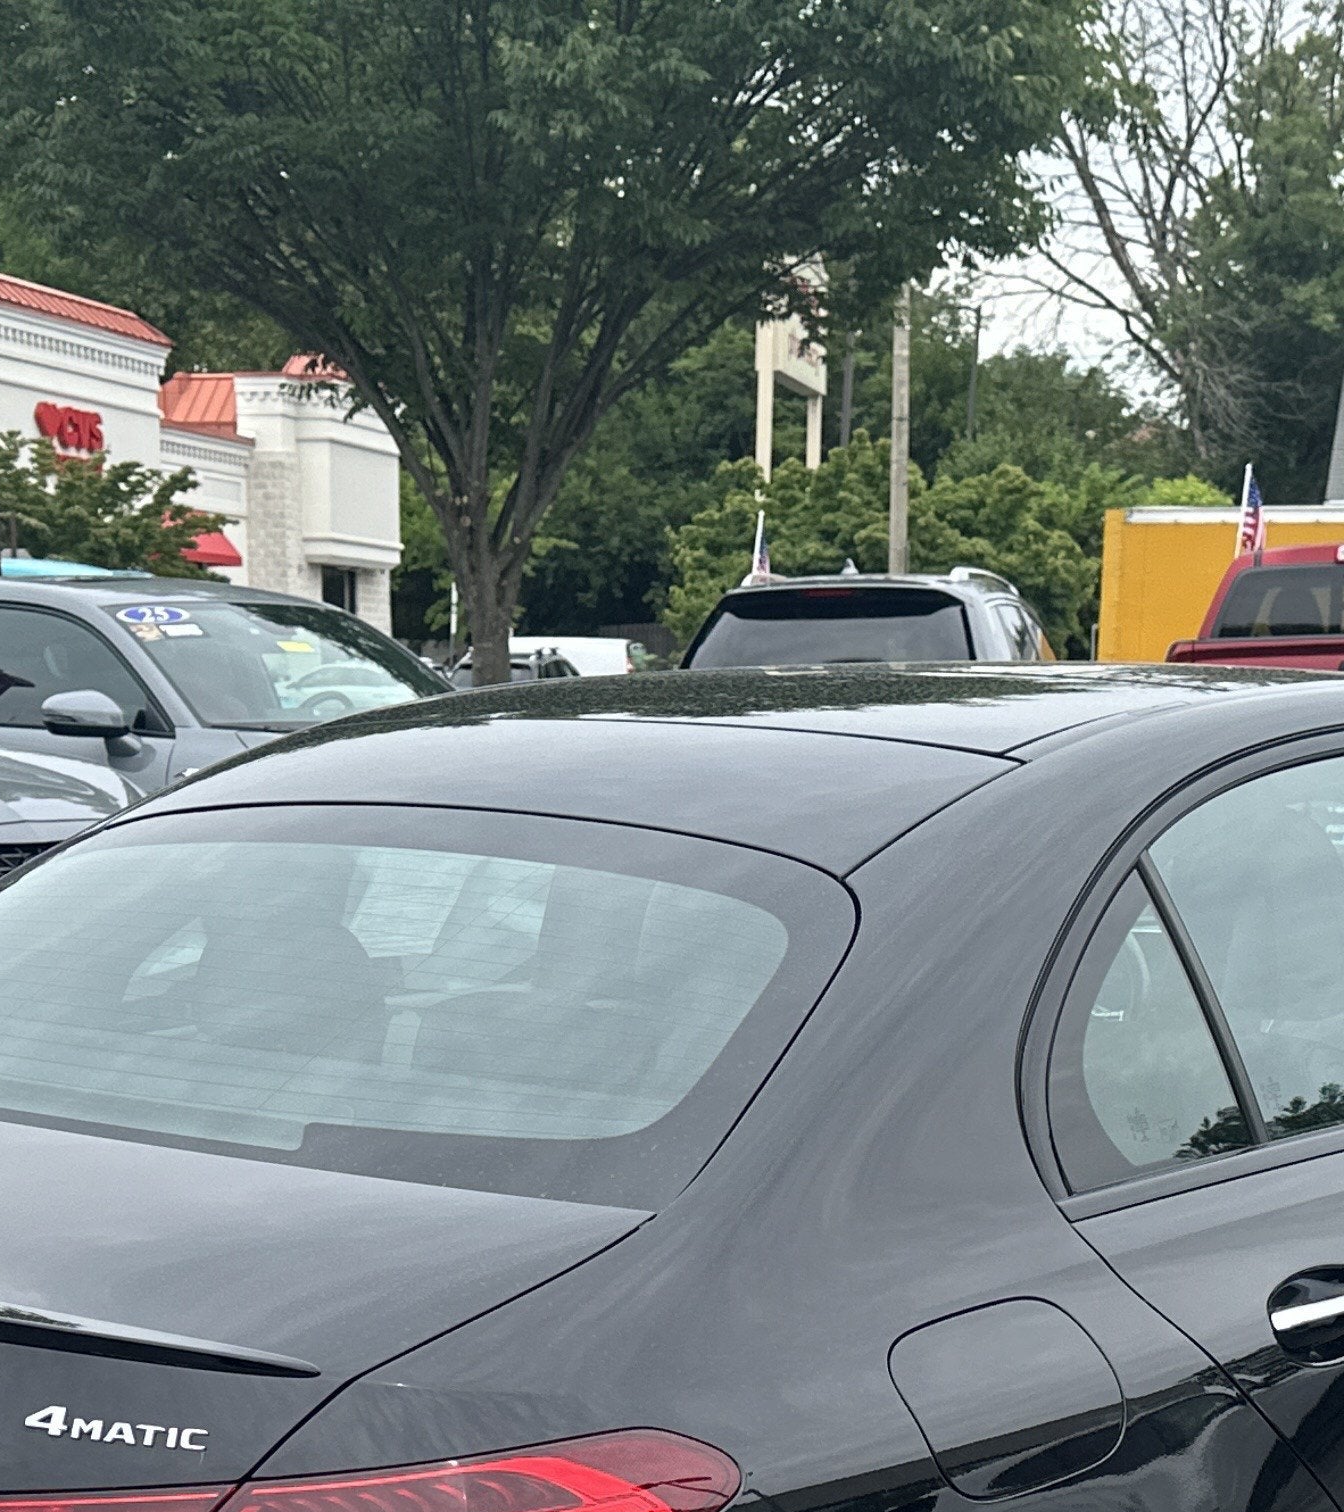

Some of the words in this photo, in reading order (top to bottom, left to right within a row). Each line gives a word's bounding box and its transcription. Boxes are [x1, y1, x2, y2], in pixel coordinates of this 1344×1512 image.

[57, 407, 104, 453] CVS
[137, 607, 170, 622] 25
[24, 1405, 209, 1451] 4MATIC
